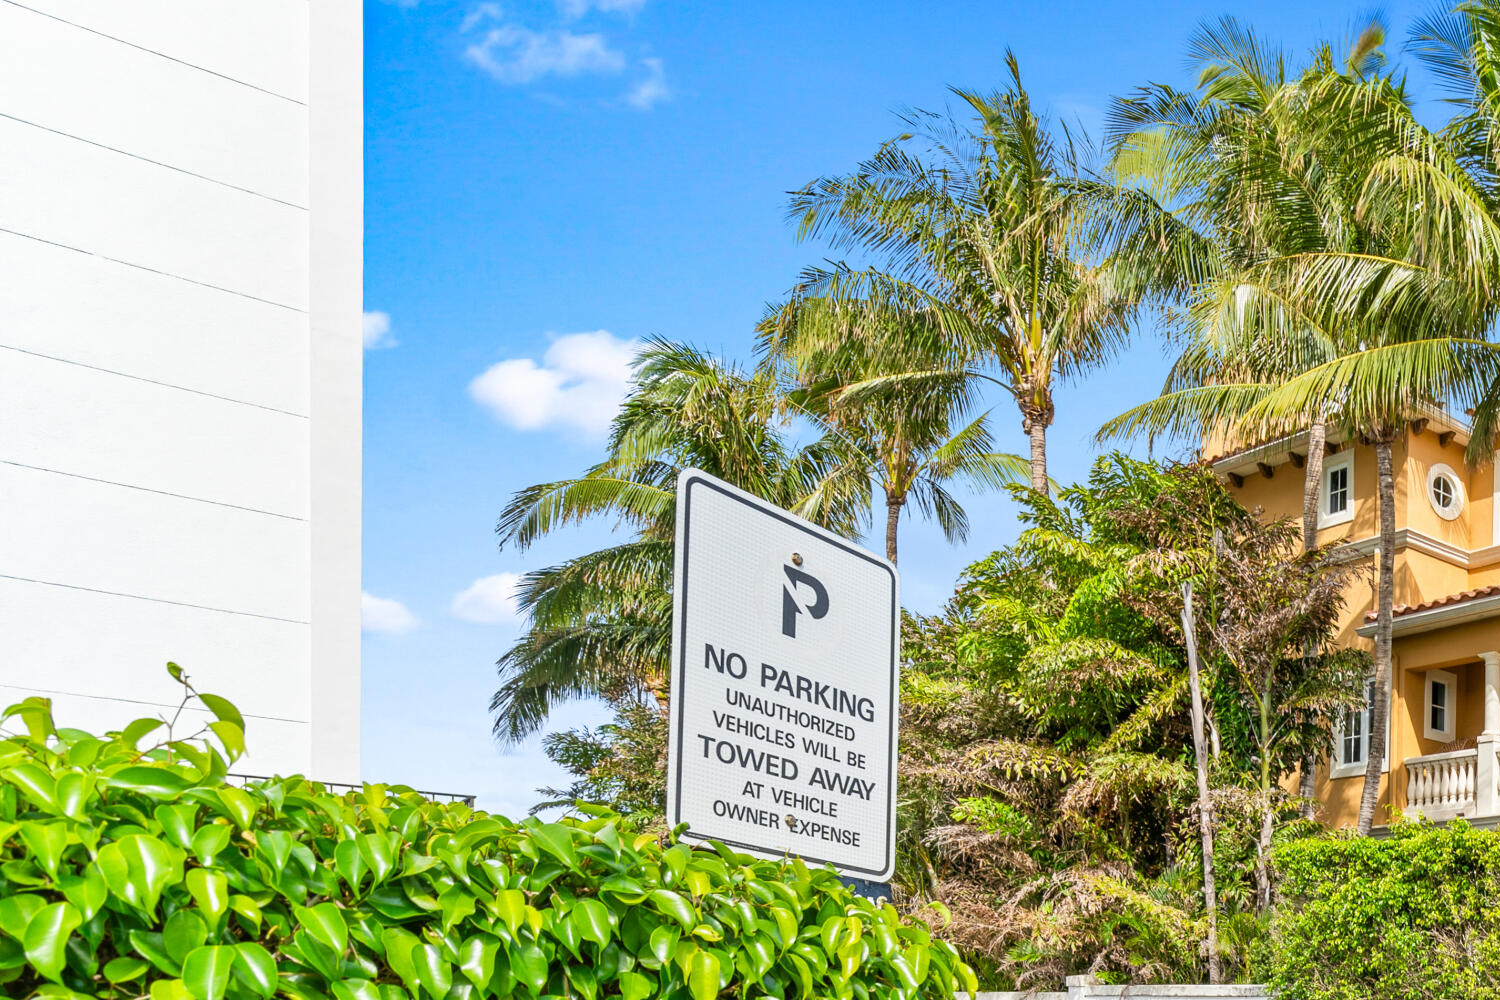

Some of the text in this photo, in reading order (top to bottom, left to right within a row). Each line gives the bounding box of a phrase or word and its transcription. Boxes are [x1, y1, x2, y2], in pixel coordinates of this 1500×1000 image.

[704, 643, 875, 722] NO PARKING
[712, 710, 866, 769] VEHICLES WILL BE
[726, 688, 855, 741] UNAUTHORIZED
[698, 734, 876, 800] TOWED AWAY
[712, 800, 780, 830] OWNER
[790, 819, 861, 847] EXPENSE
[742, 781, 838, 818] AT VEHICLE
